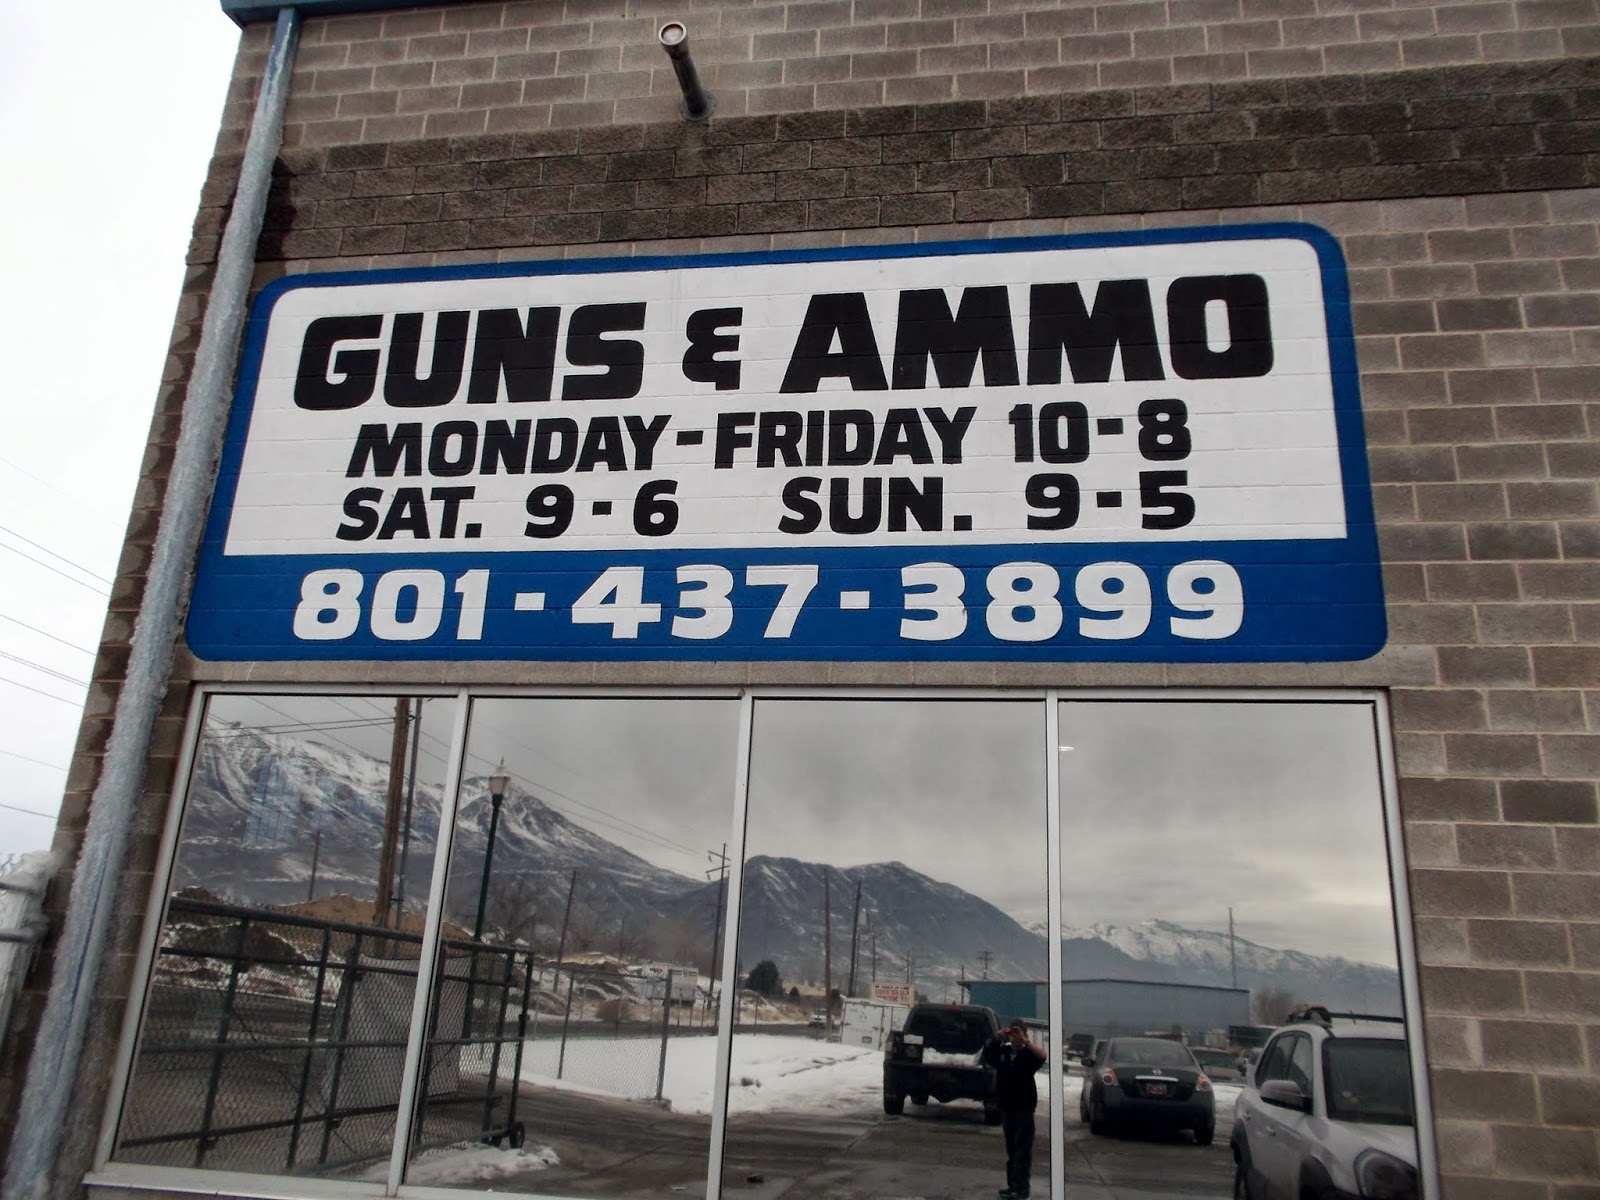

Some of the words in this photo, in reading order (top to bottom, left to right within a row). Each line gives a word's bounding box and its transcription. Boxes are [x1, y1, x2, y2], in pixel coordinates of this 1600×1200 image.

[293, 302, 647, 410] GUNS
[682, 307, 743, 390] &
[779, 273, 1274, 393] AMMO
[1008, 398, 1192, 463] 10-8
[336, 486, 482, 541] SAT.
[778, 476, 973, 534] SUN.
